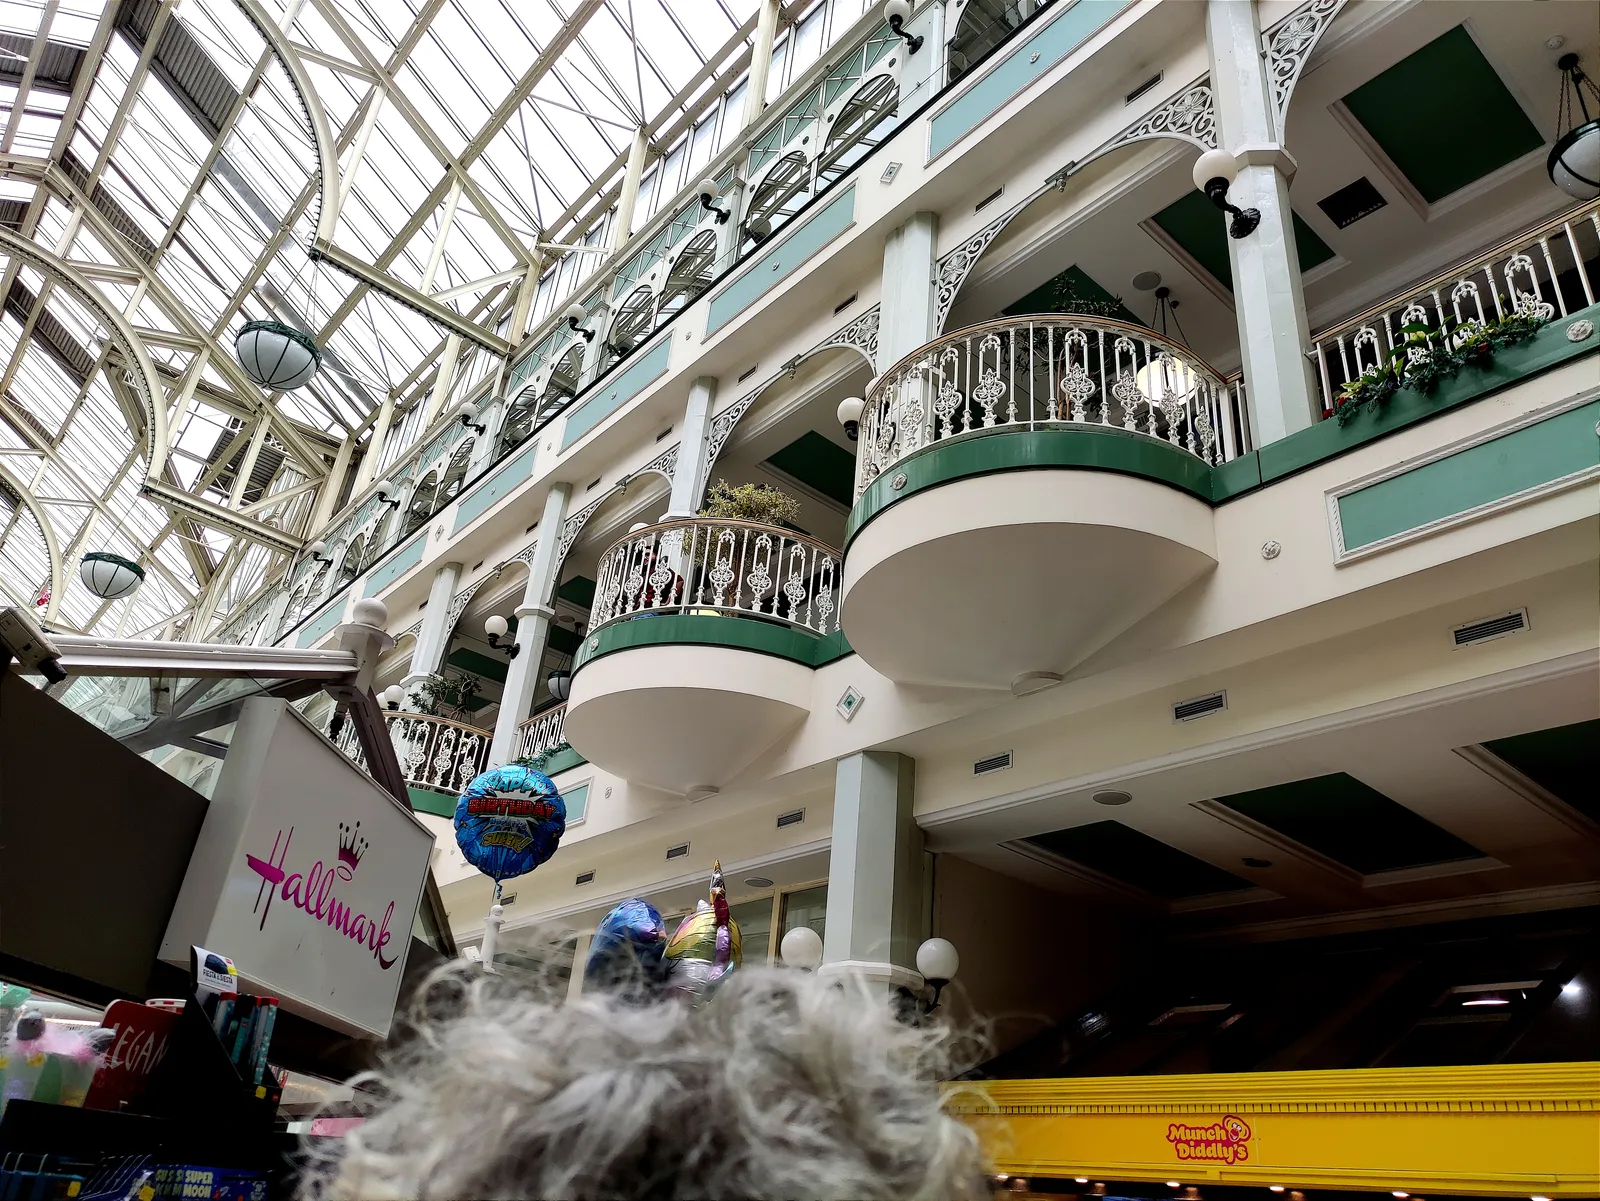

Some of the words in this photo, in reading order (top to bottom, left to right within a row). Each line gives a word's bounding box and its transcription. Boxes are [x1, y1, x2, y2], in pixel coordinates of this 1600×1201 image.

[487, 775, 547, 795] HAPPY
[468, 798, 557, 819] BIRTHDAY
[482, 831, 533, 853] SUPER!
[246, 826, 400, 970] Hallmark
[203, 968, 217, 979] FIESTA
[220, 973, 233, 984] SIESTA
[1168, 1125, 1227, 1141] Munch
[1176, 1141, 1247, 1163] Diddly's
[184, 1169, 214, 1184] SUPER
[182, 1183, 212, 1198] MOON
